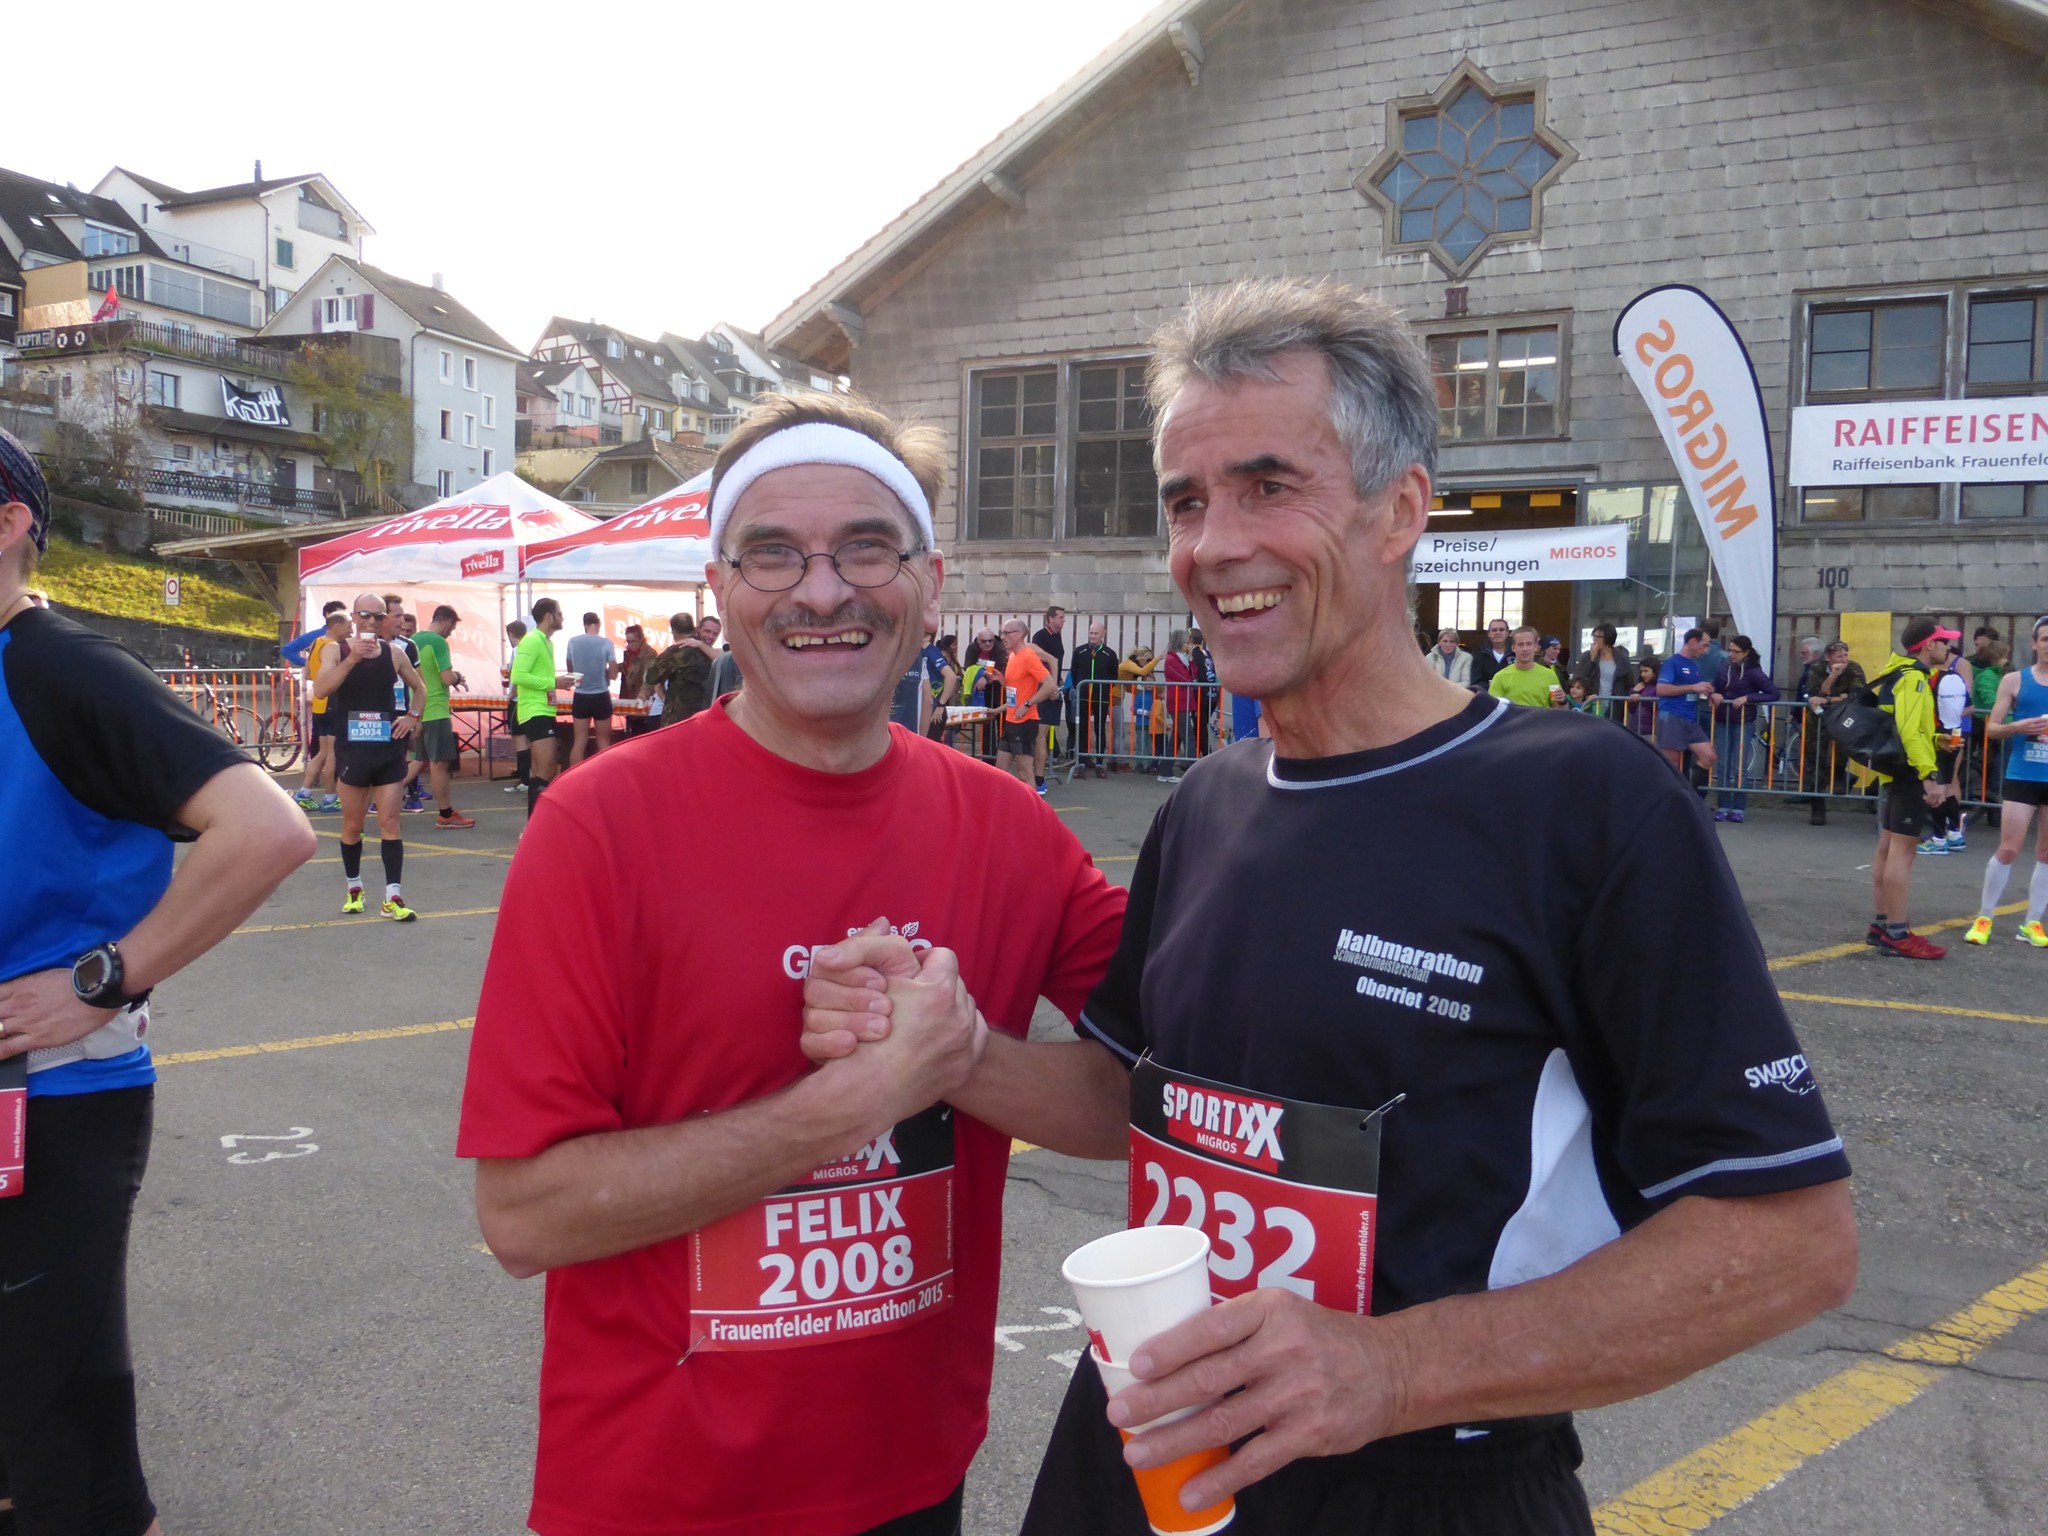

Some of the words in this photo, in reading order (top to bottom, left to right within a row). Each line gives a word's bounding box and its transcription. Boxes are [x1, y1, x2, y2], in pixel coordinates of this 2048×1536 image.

[1832, 456, 1955, 471] Raiffeisenbank
[368, 508, 510, 538] rivella
[1433, 537, 1498, 553] Preise/
[1550, 546, 1617, 560] MIGROS
[465, 555, 500, 573] rivella
[1415, 559, 1540, 575] szeichnungen
[1816, 567, 1849, 589] 100
[359, 728, 382, 736] 3034
[1336, 928, 1485, 984] Halbmarathon
[1356, 975, 1423, 1009] Oberriet
[1426, 994, 1471, 1021] 2008
[1196, 1132, 1237, 1154] MIGROS
[813, 1164, 859, 1181] MIGROS
[765, 1186, 906, 1247] FELIX
[758, 1234, 914, 1306] 2008
[710, 1313, 833, 1341] Frauenfelder
[836, 1299, 917, 1331] Marathon
[918, 1281, 944, 1311] 2015
